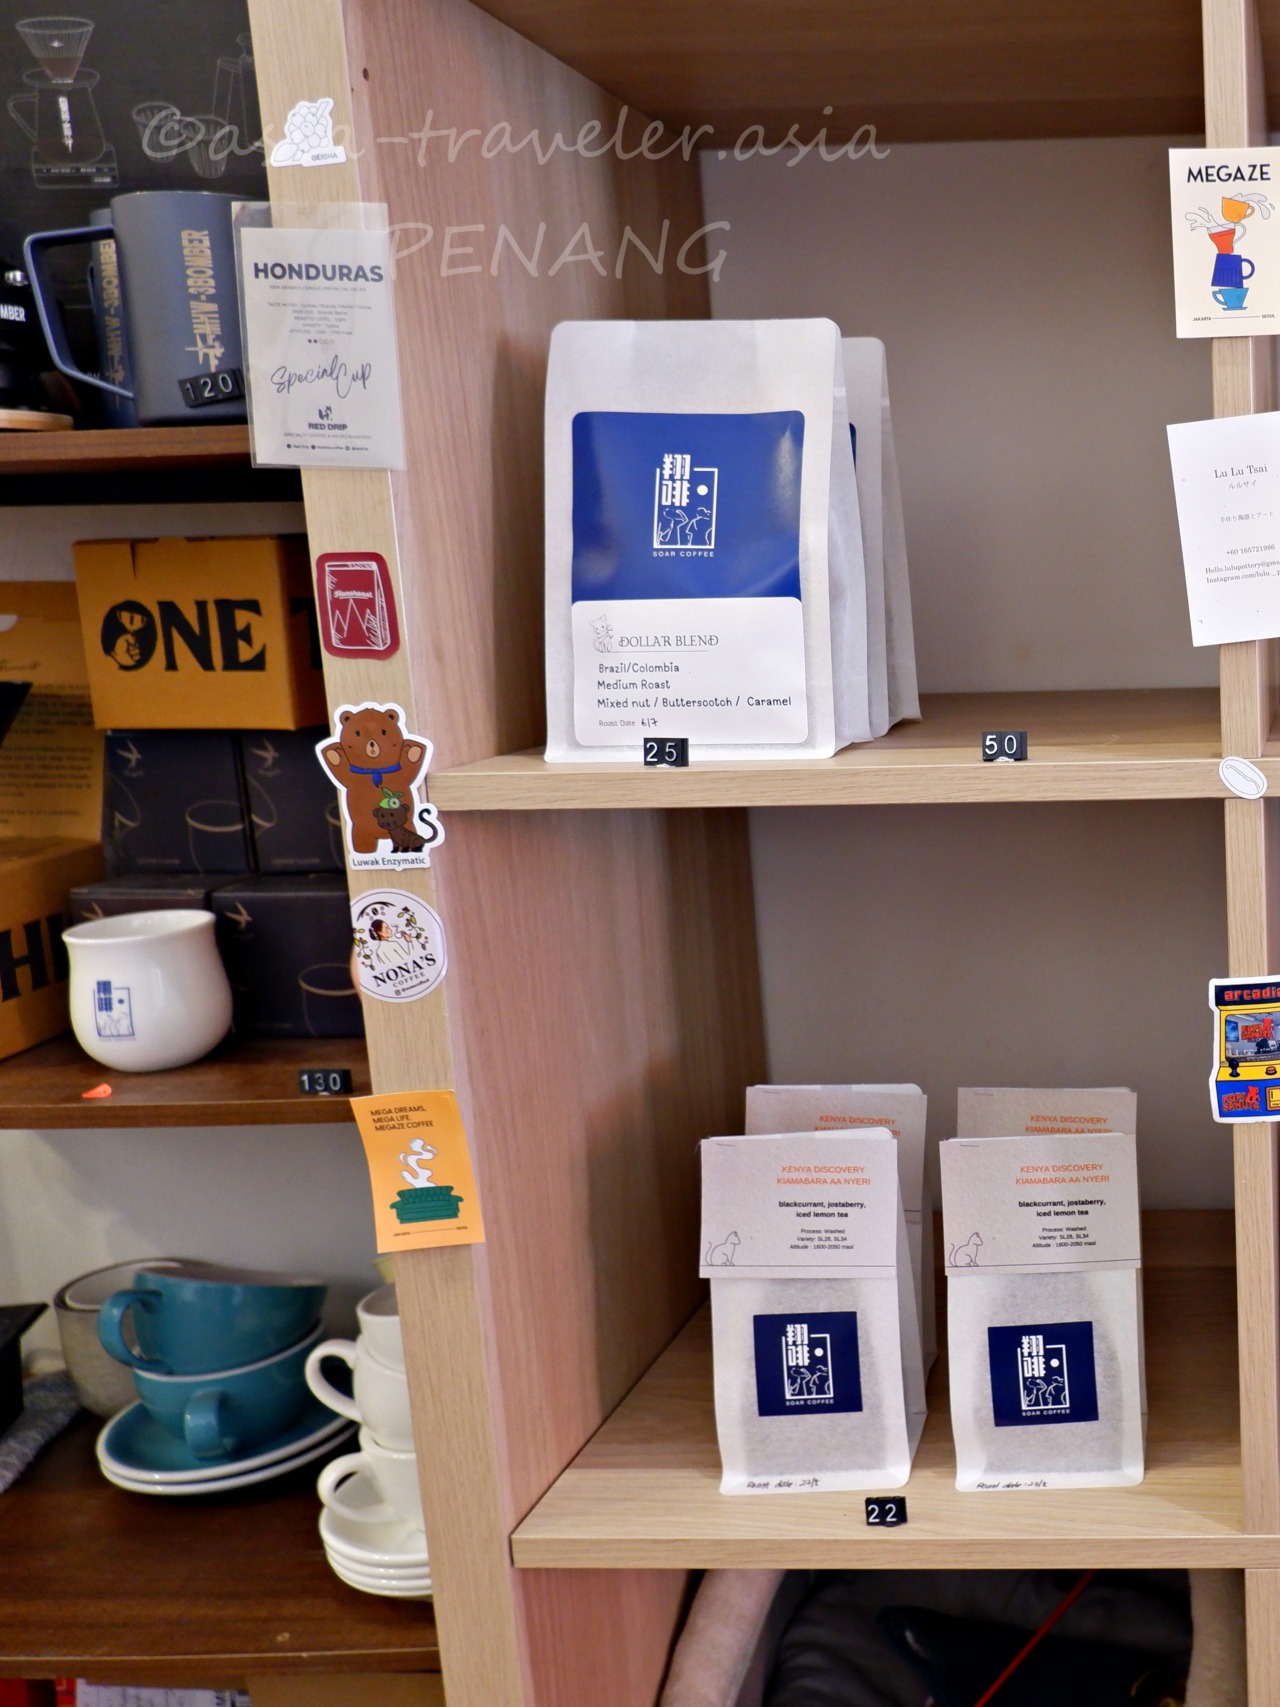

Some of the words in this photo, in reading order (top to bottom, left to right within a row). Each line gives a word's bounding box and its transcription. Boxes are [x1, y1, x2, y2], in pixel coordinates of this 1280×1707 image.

[311, 153, 338, 161] GEISHA
[1187, 164, 1271, 183] MEGAZE
[254, 262, 384, 282] HONDURAS
[185, 373, 232, 400] 120
[1214, 469, 1228, 479] Lu
[1231, 467, 1244, 476] Lu
[1247, 464, 1268, 475] Tsai
[680, 550, 714, 558] COFFEE
[101, 598, 266, 672] ONE
[619, 636, 673, 648] DOLLAR
[676, 635, 719, 647] BLEND
[599, 662, 680, 673] Brazil/Colombia
[597, 680, 638, 690] Medium
[641, 680, 670, 689] Roast
[597, 698, 629, 708] Mixed
[632, 700, 650, 708] nut
[662, 697, 732, 707] Butterscotch
[747, 696, 792, 706] Caramel
[985, 735, 1017, 755] 50
[646, 742, 677, 762] 25
[352, 858, 380, 866] Luwak
[382, 857, 426, 867] Enzymatic
[372, 953, 436, 987] NONA'S
[393, 971, 425, 988] COFFEE
[300, 1073, 340, 1090] 130
[370, 1108, 392, 1116] MEGA
[373, 1116, 394, 1124] MEGA
[375, 1123, 405, 1131] MEGAZE
[1052, 1164, 1103, 1172] DISCOVERY
[1015, 1177, 1066, 1185] KIAMABARA
[1083, 1175, 1110, 1183] NYERI
[779, 1201, 825, 1209] blackcurrant,
[828, 1201, 866, 1209] jostaberry,
[868, 1504, 897, 1522] 22
